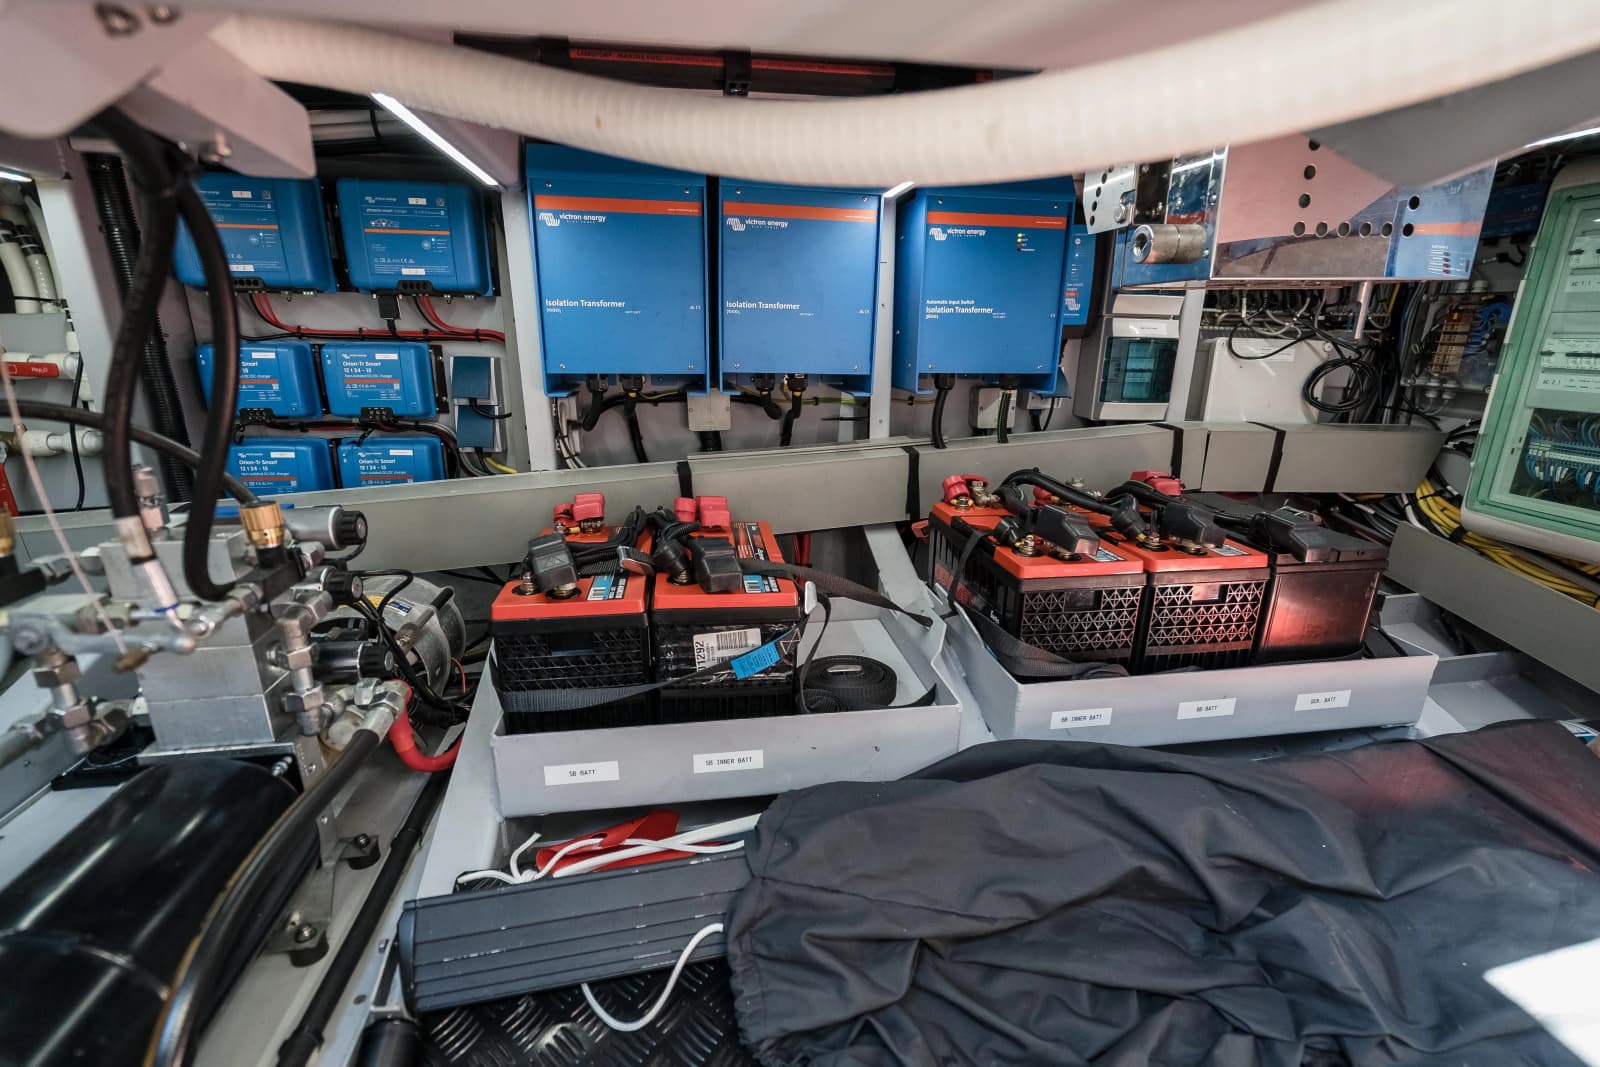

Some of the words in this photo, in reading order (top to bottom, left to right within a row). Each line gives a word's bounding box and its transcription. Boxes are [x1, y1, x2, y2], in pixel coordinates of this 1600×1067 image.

[559, 212, 582, 221] victron
[583, 214, 607, 224] energy
[745, 218, 766, 226] victron
[767, 220, 789, 228] energy
[966, 229, 986, 237] energy
[545, 298, 578, 307] Isolation
[580, 299, 626, 308] Transformer
[726, 301, 757, 309] Isolation
[758, 302, 801, 310] Transformer
[926, 306, 954, 314] Isolation
[954, 306, 994, 314] Transformer
[717, 758, 735, 766] INNER
[737, 756, 752, 764] BATT
